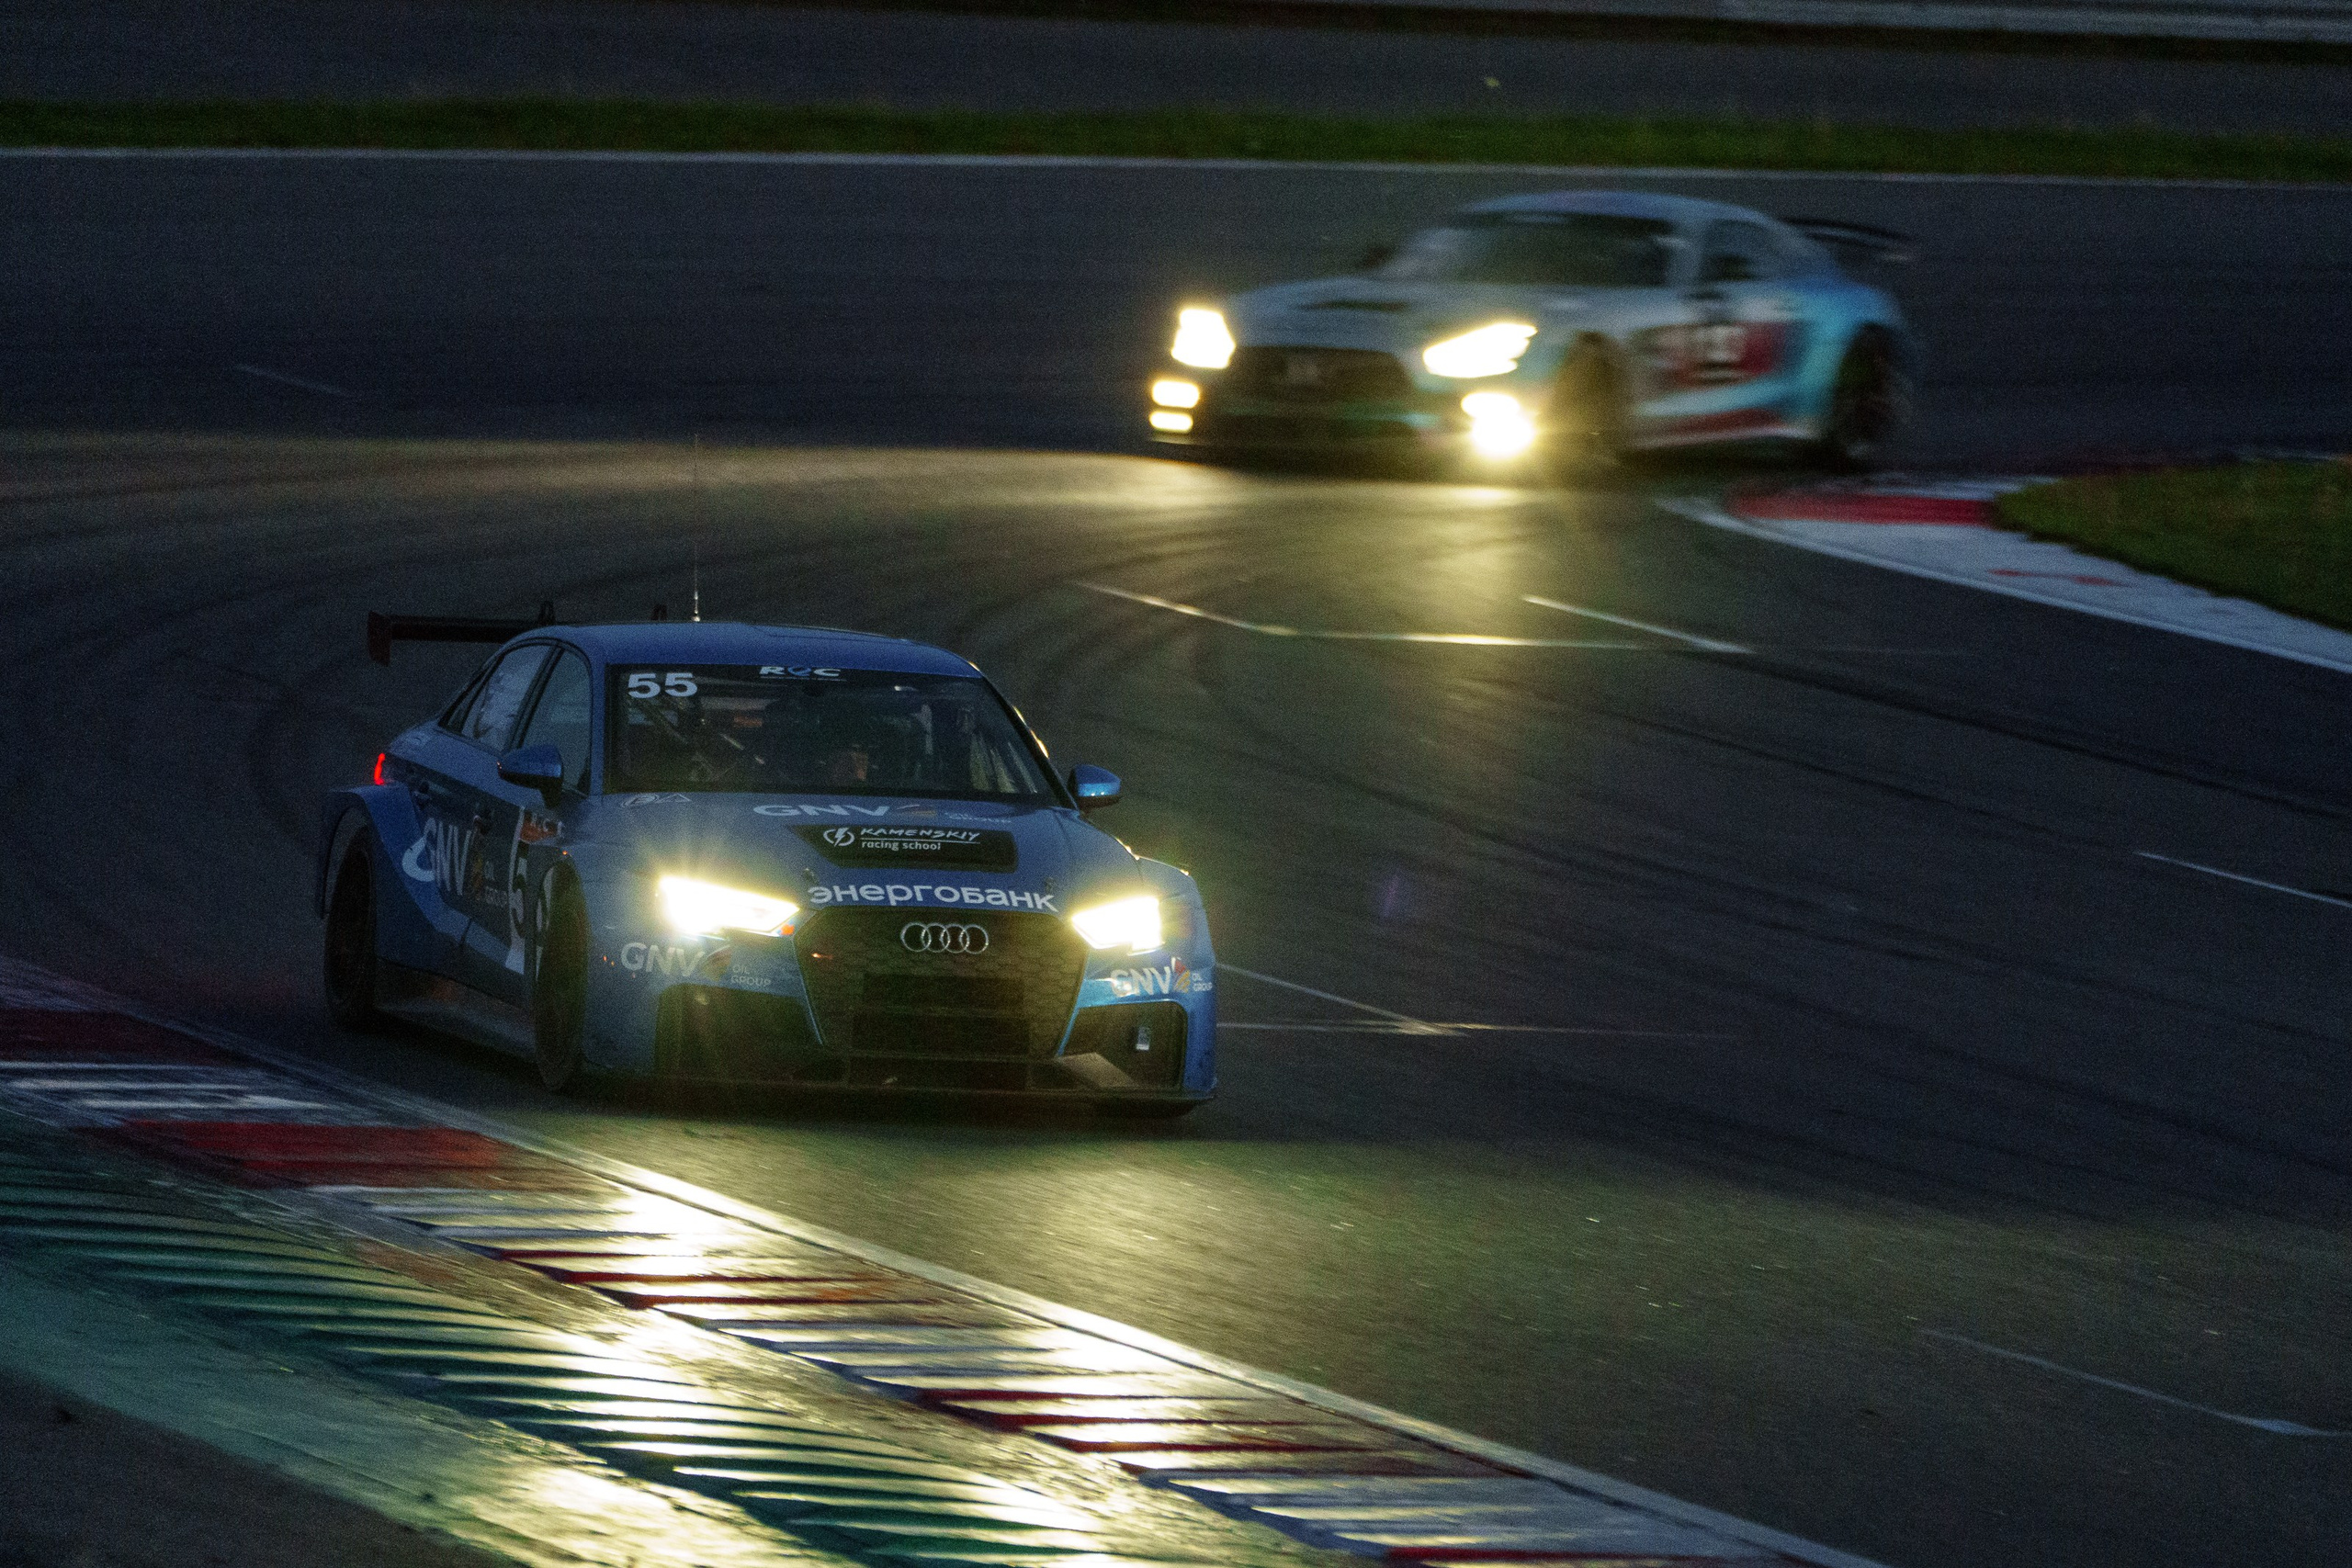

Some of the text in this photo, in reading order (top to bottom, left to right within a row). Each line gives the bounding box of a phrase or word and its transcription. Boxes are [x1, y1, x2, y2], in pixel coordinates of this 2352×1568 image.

[627, 671, 698, 699] 55
[752, 805, 890, 817] GNV
[860, 827, 980, 840] KAMENSKIY
[861, 840, 942, 852] racing school
[620, 942, 706, 977] GNV
[729, 974, 772, 988] GROUP
[1110, 965, 1171, 998] GNV
